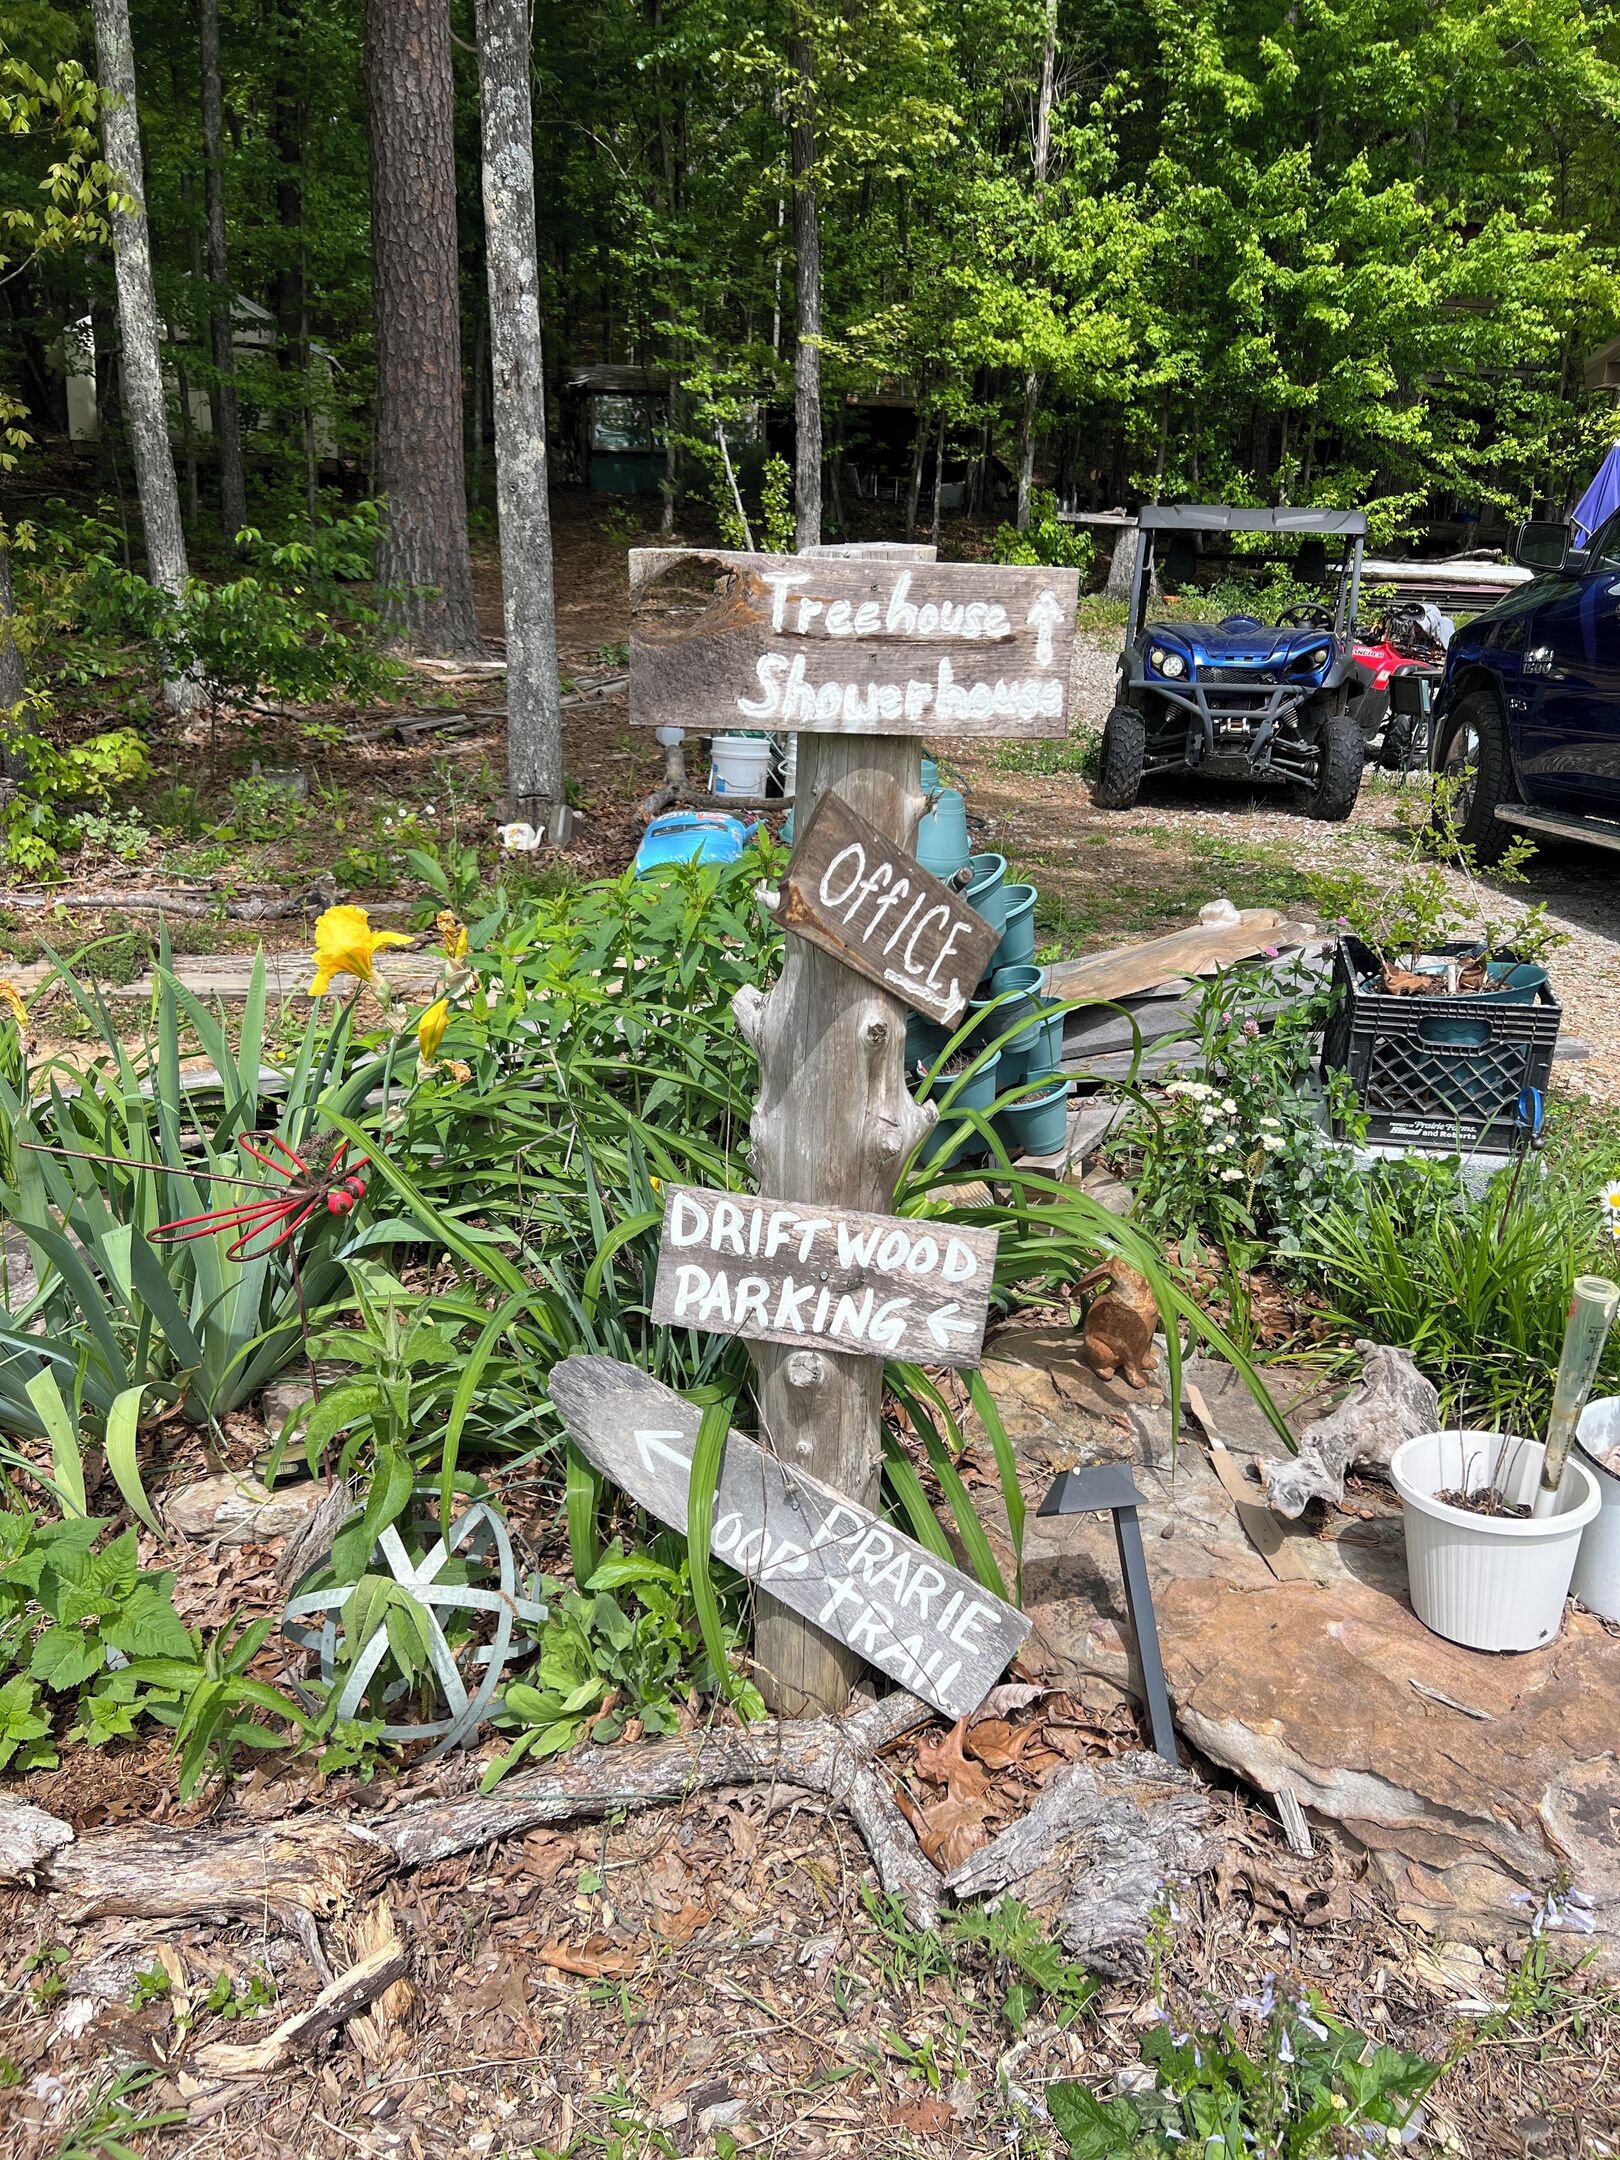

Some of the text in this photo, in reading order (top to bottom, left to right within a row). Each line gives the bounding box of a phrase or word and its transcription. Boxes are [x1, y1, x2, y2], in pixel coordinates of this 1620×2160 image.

[763, 569, 1011, 640] Treehouse
[737, 652, 1064, 722] Showerhouse
[1414, 1120, 1445, 1131] Prairie
[1440, 1131, 1477, 1140] Roberts
[673, 1264, 912, 1349] PARKING
[711, 1490, 810, 1582] OOP
[809, 1504, 1001, 1655] PRARIE
